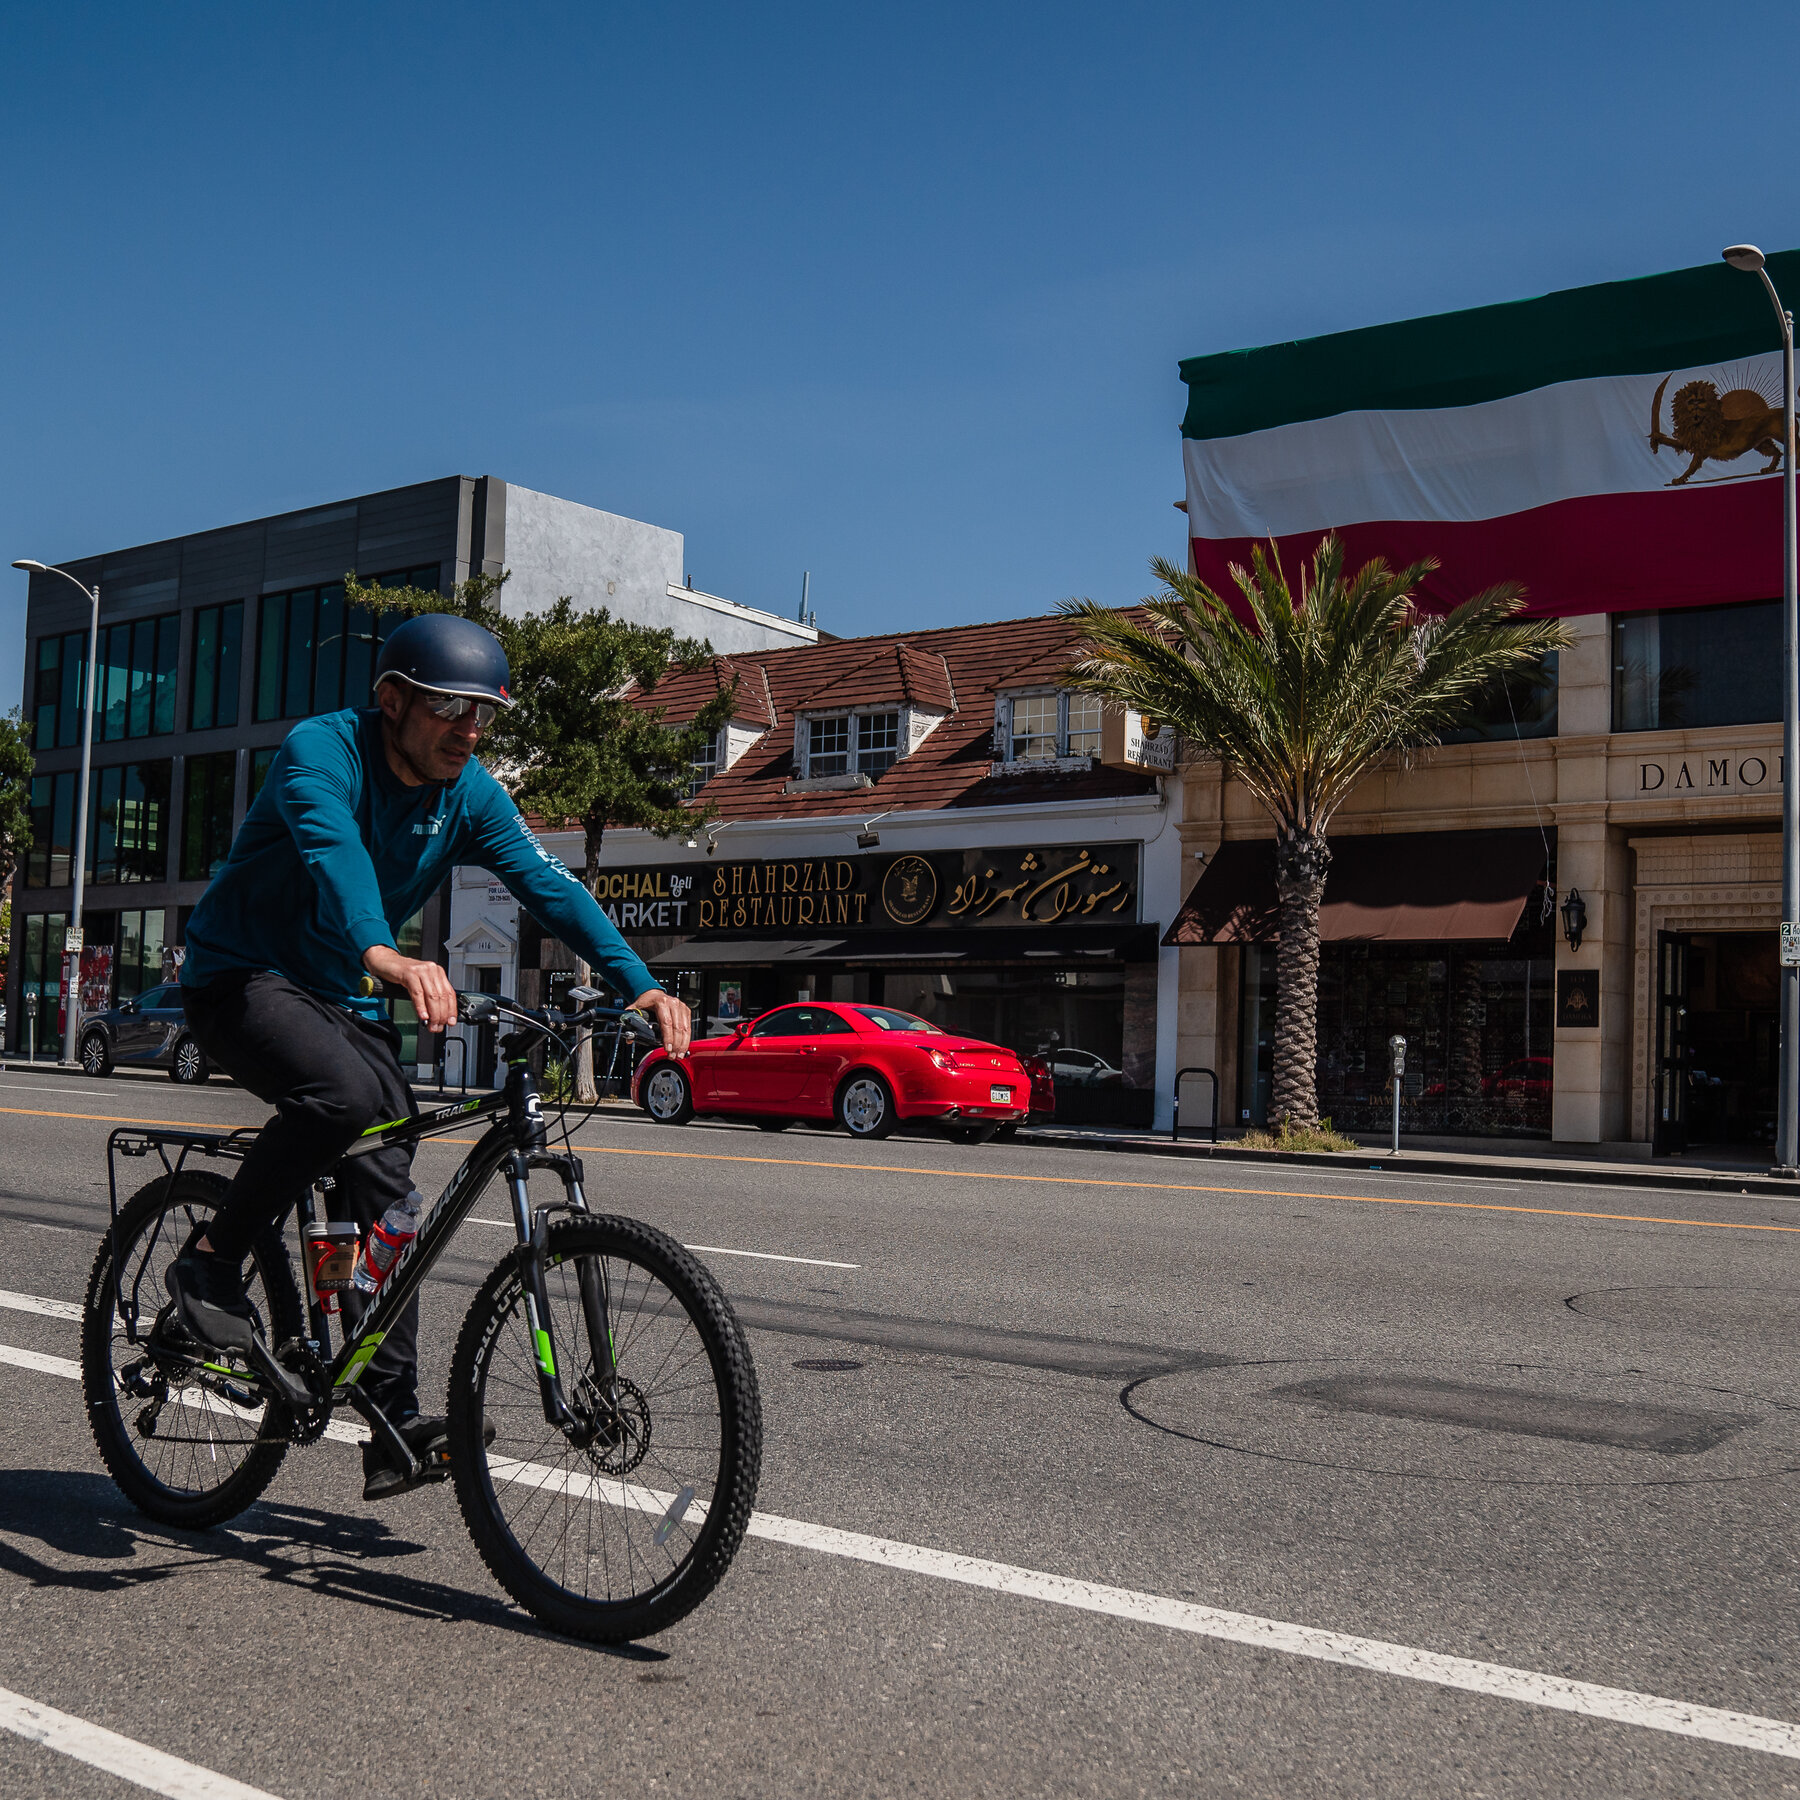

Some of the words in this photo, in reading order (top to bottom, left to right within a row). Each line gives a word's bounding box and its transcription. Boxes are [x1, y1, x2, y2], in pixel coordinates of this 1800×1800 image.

[1127, 749, 1172, 768] RESTAURANT
[1130, 738, 1169, 755] SHAHRZAD
[582, 872, 670, 899] OCHAL
[671, 875, 693, 889] Deli
[713, 861, 854, 897] SHAHRZAD
[947, 852, 1037, 917] شهرزاد
[1021, 850, 1129, 923] رستوران
[600, 901, 688, 928] ARKET
[699, 892, 867, 928] RESTAURANT
[1782, 924, 1790, 935] 2
[478, 942, 491, 950] 1416
[1368, 1095, 1417, 1106] DAMKA
